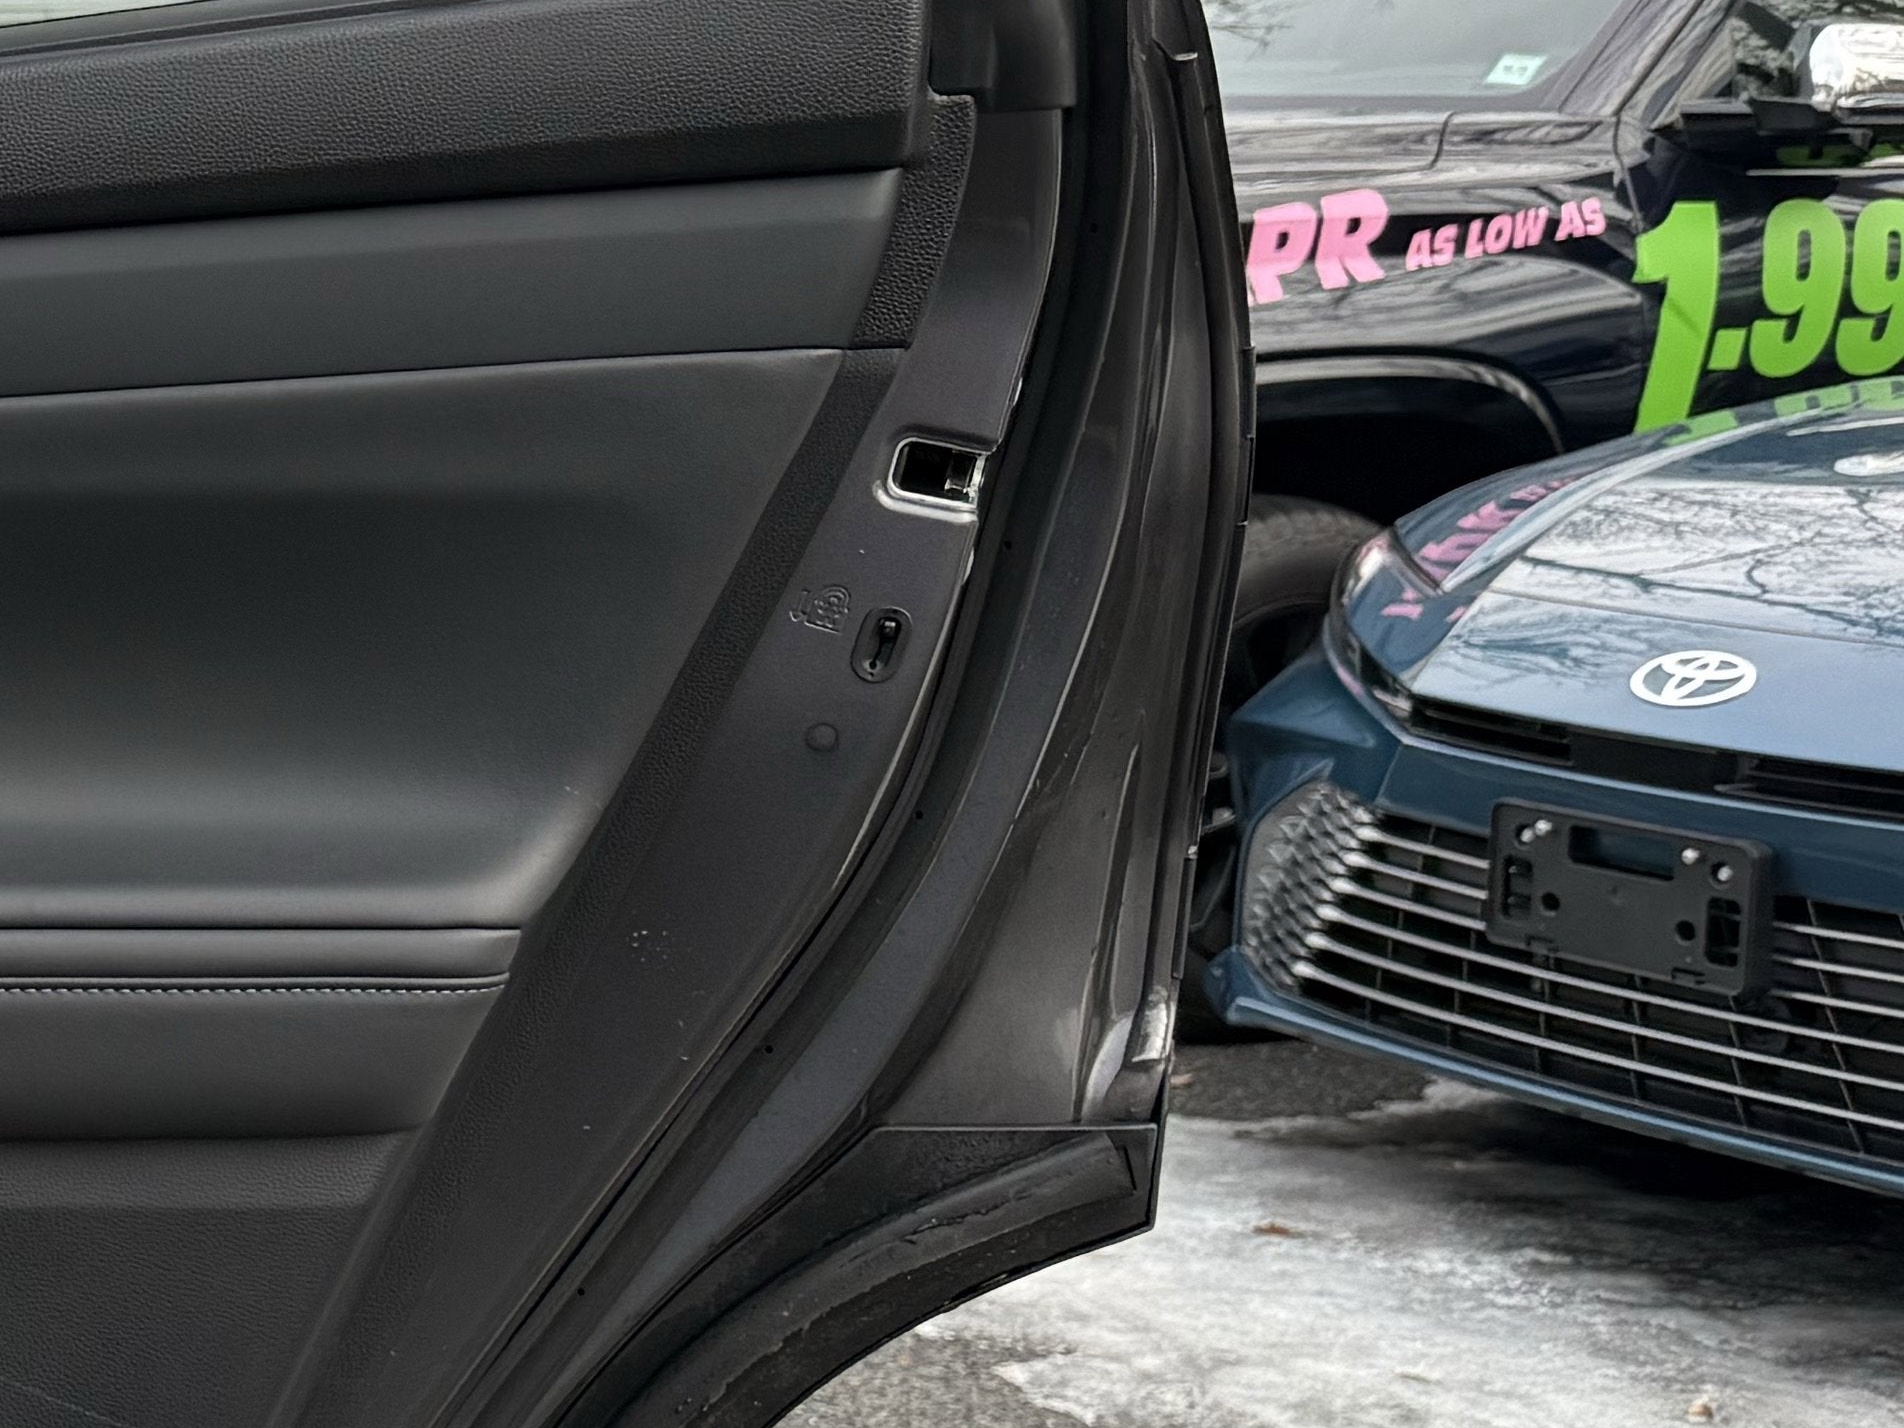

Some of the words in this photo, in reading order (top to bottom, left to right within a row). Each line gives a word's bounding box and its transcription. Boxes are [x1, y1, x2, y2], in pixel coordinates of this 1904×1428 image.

[1246, 188, 1389, 306] PR
[1405, 223, 1456, 272] AS
[1464, 205, 1550, 260] LOW
[1555, 196, 1606, 243] AS
[1633, 199, 1904, 435] 1.99
